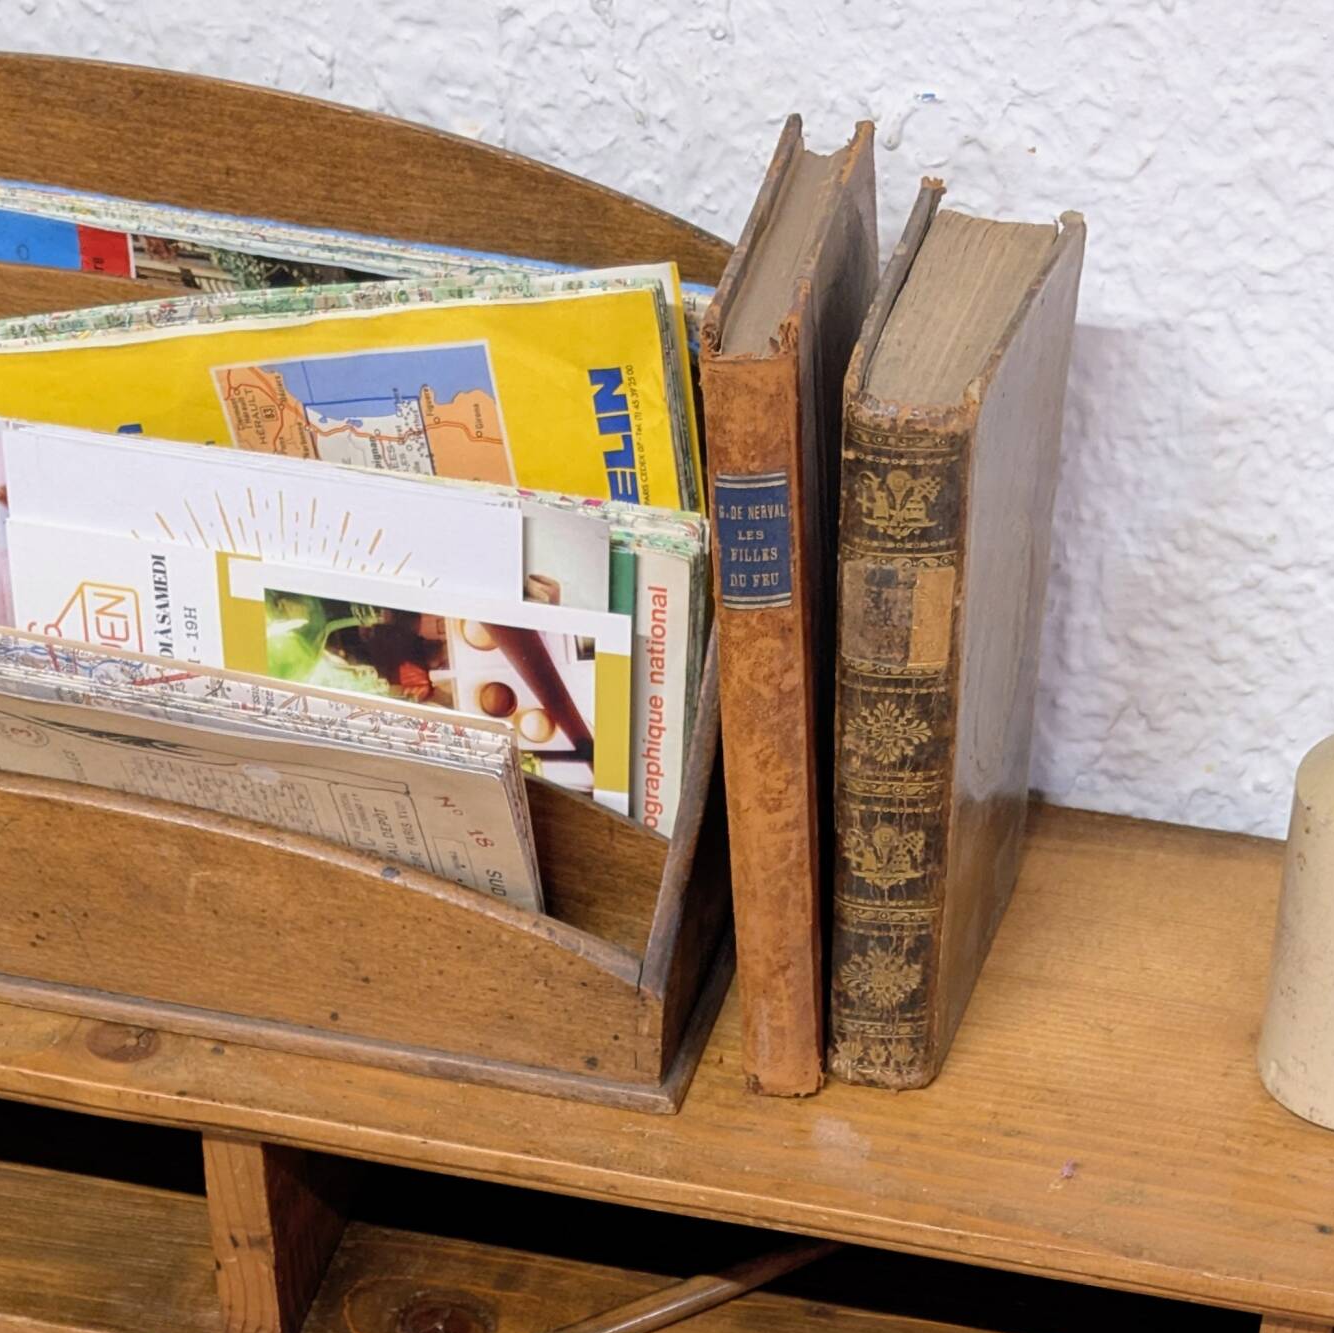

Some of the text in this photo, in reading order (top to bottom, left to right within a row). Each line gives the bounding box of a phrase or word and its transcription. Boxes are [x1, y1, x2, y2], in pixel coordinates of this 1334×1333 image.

[264, 408, 276, 420] 83
[747, 504, 786, 520] NERVAL
[737, 530, 764, 541] LES
[730, 547, 778, 562] FILLES
[730, 572, 780, 587] DU FEU
[151, 554, 171, 626] SAMEDI
[641, 586, 668, 830] ographique national
